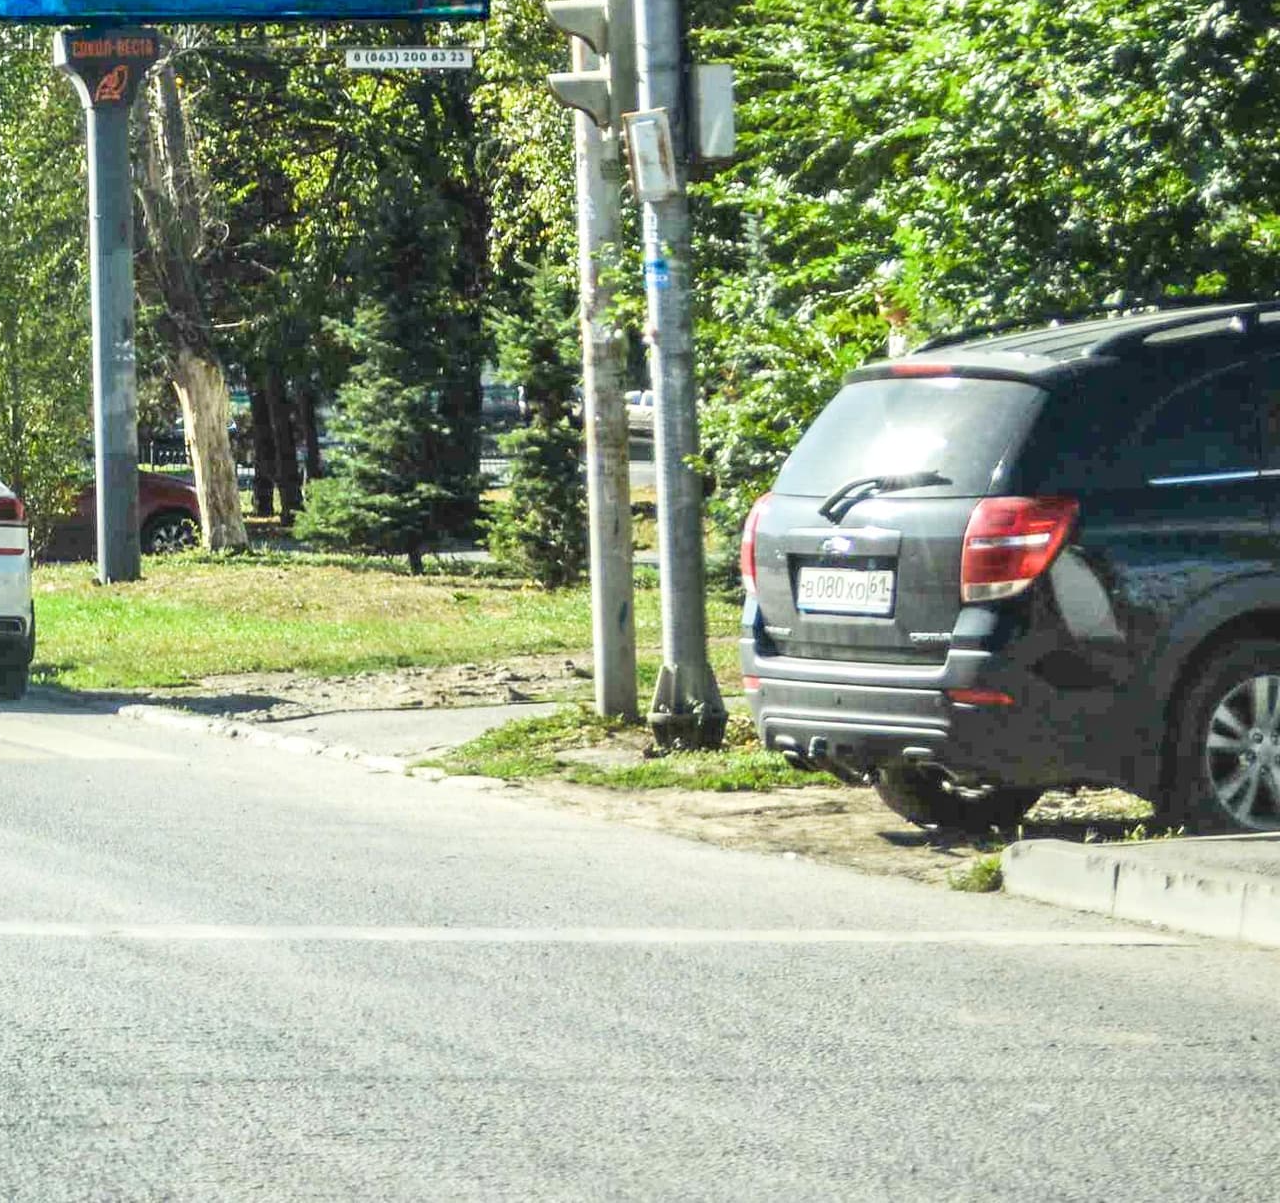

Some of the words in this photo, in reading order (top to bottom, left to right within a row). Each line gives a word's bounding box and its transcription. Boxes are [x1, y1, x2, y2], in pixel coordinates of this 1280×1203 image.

[403, 52, 427, 62] 200
[450, 52, 465, 62] 23
[869, 575, 886, 594] 61
